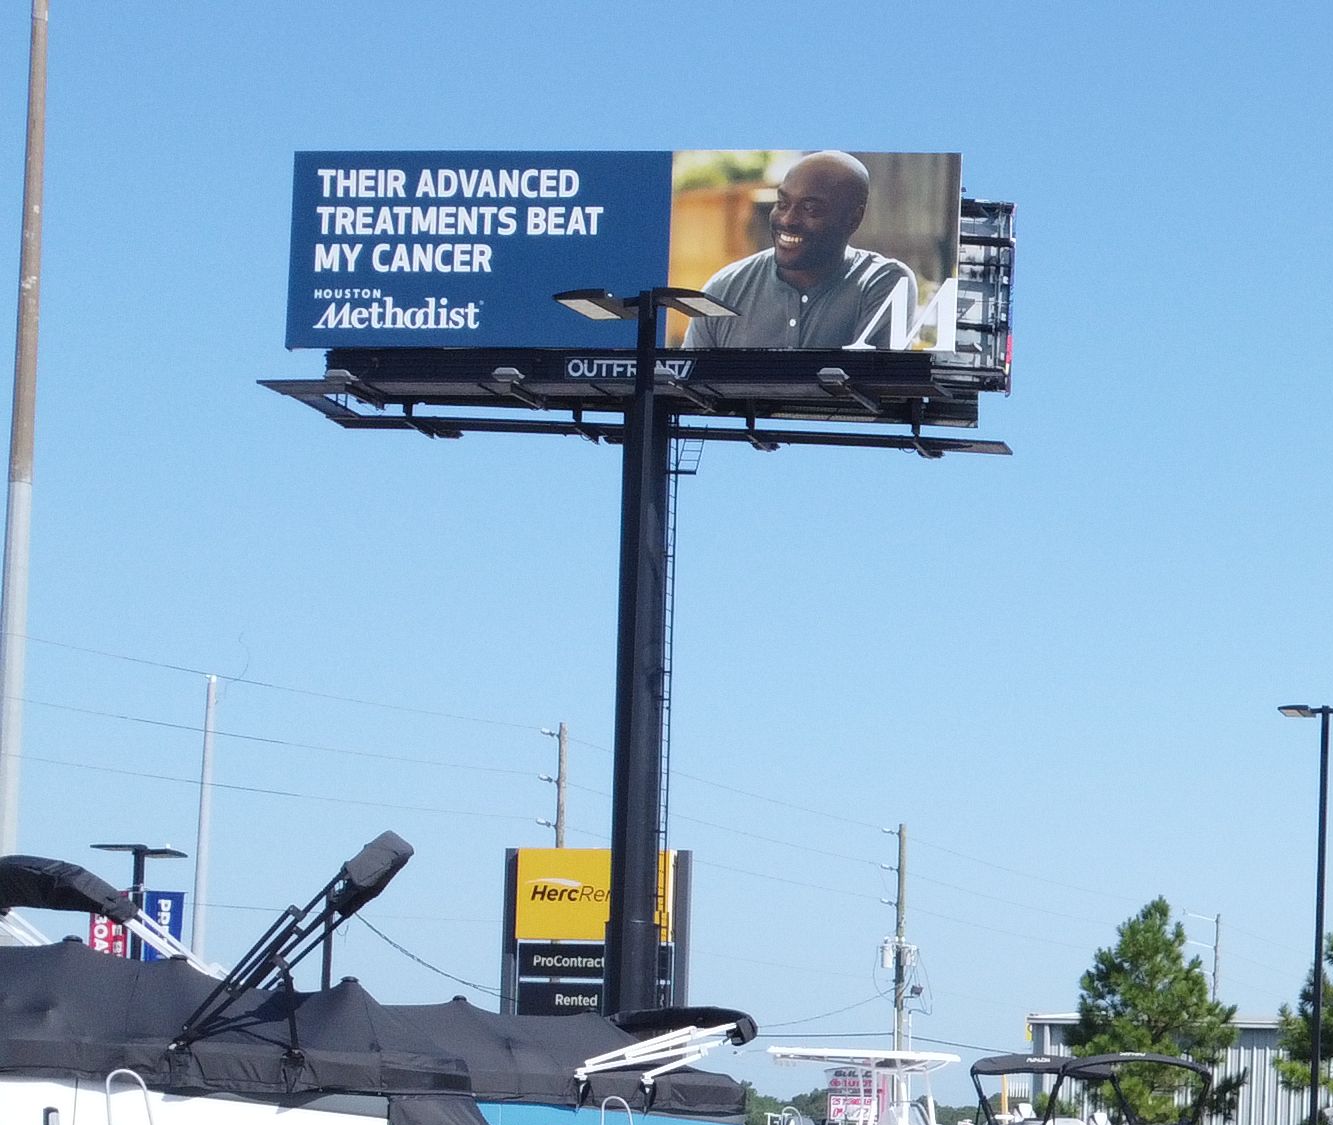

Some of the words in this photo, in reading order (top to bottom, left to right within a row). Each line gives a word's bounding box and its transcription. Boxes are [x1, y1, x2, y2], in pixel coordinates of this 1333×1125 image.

[317, 168, 407, 198] THEIR
[415, 168, 580, 198] ADVANCED
[316, 206, 517, 236] TREATMENTS
[526, 206, 604, 236] BEAT
[314, 243, 363, 272] MY
[372, 243, 493, 273] CANCER
[314, 288, 382, 299] HOUSTON
[312, 296, 481, 329] Methodist
[531, 885, 610, 902] HercRe
[555, 993, 598, 1007] Rented
